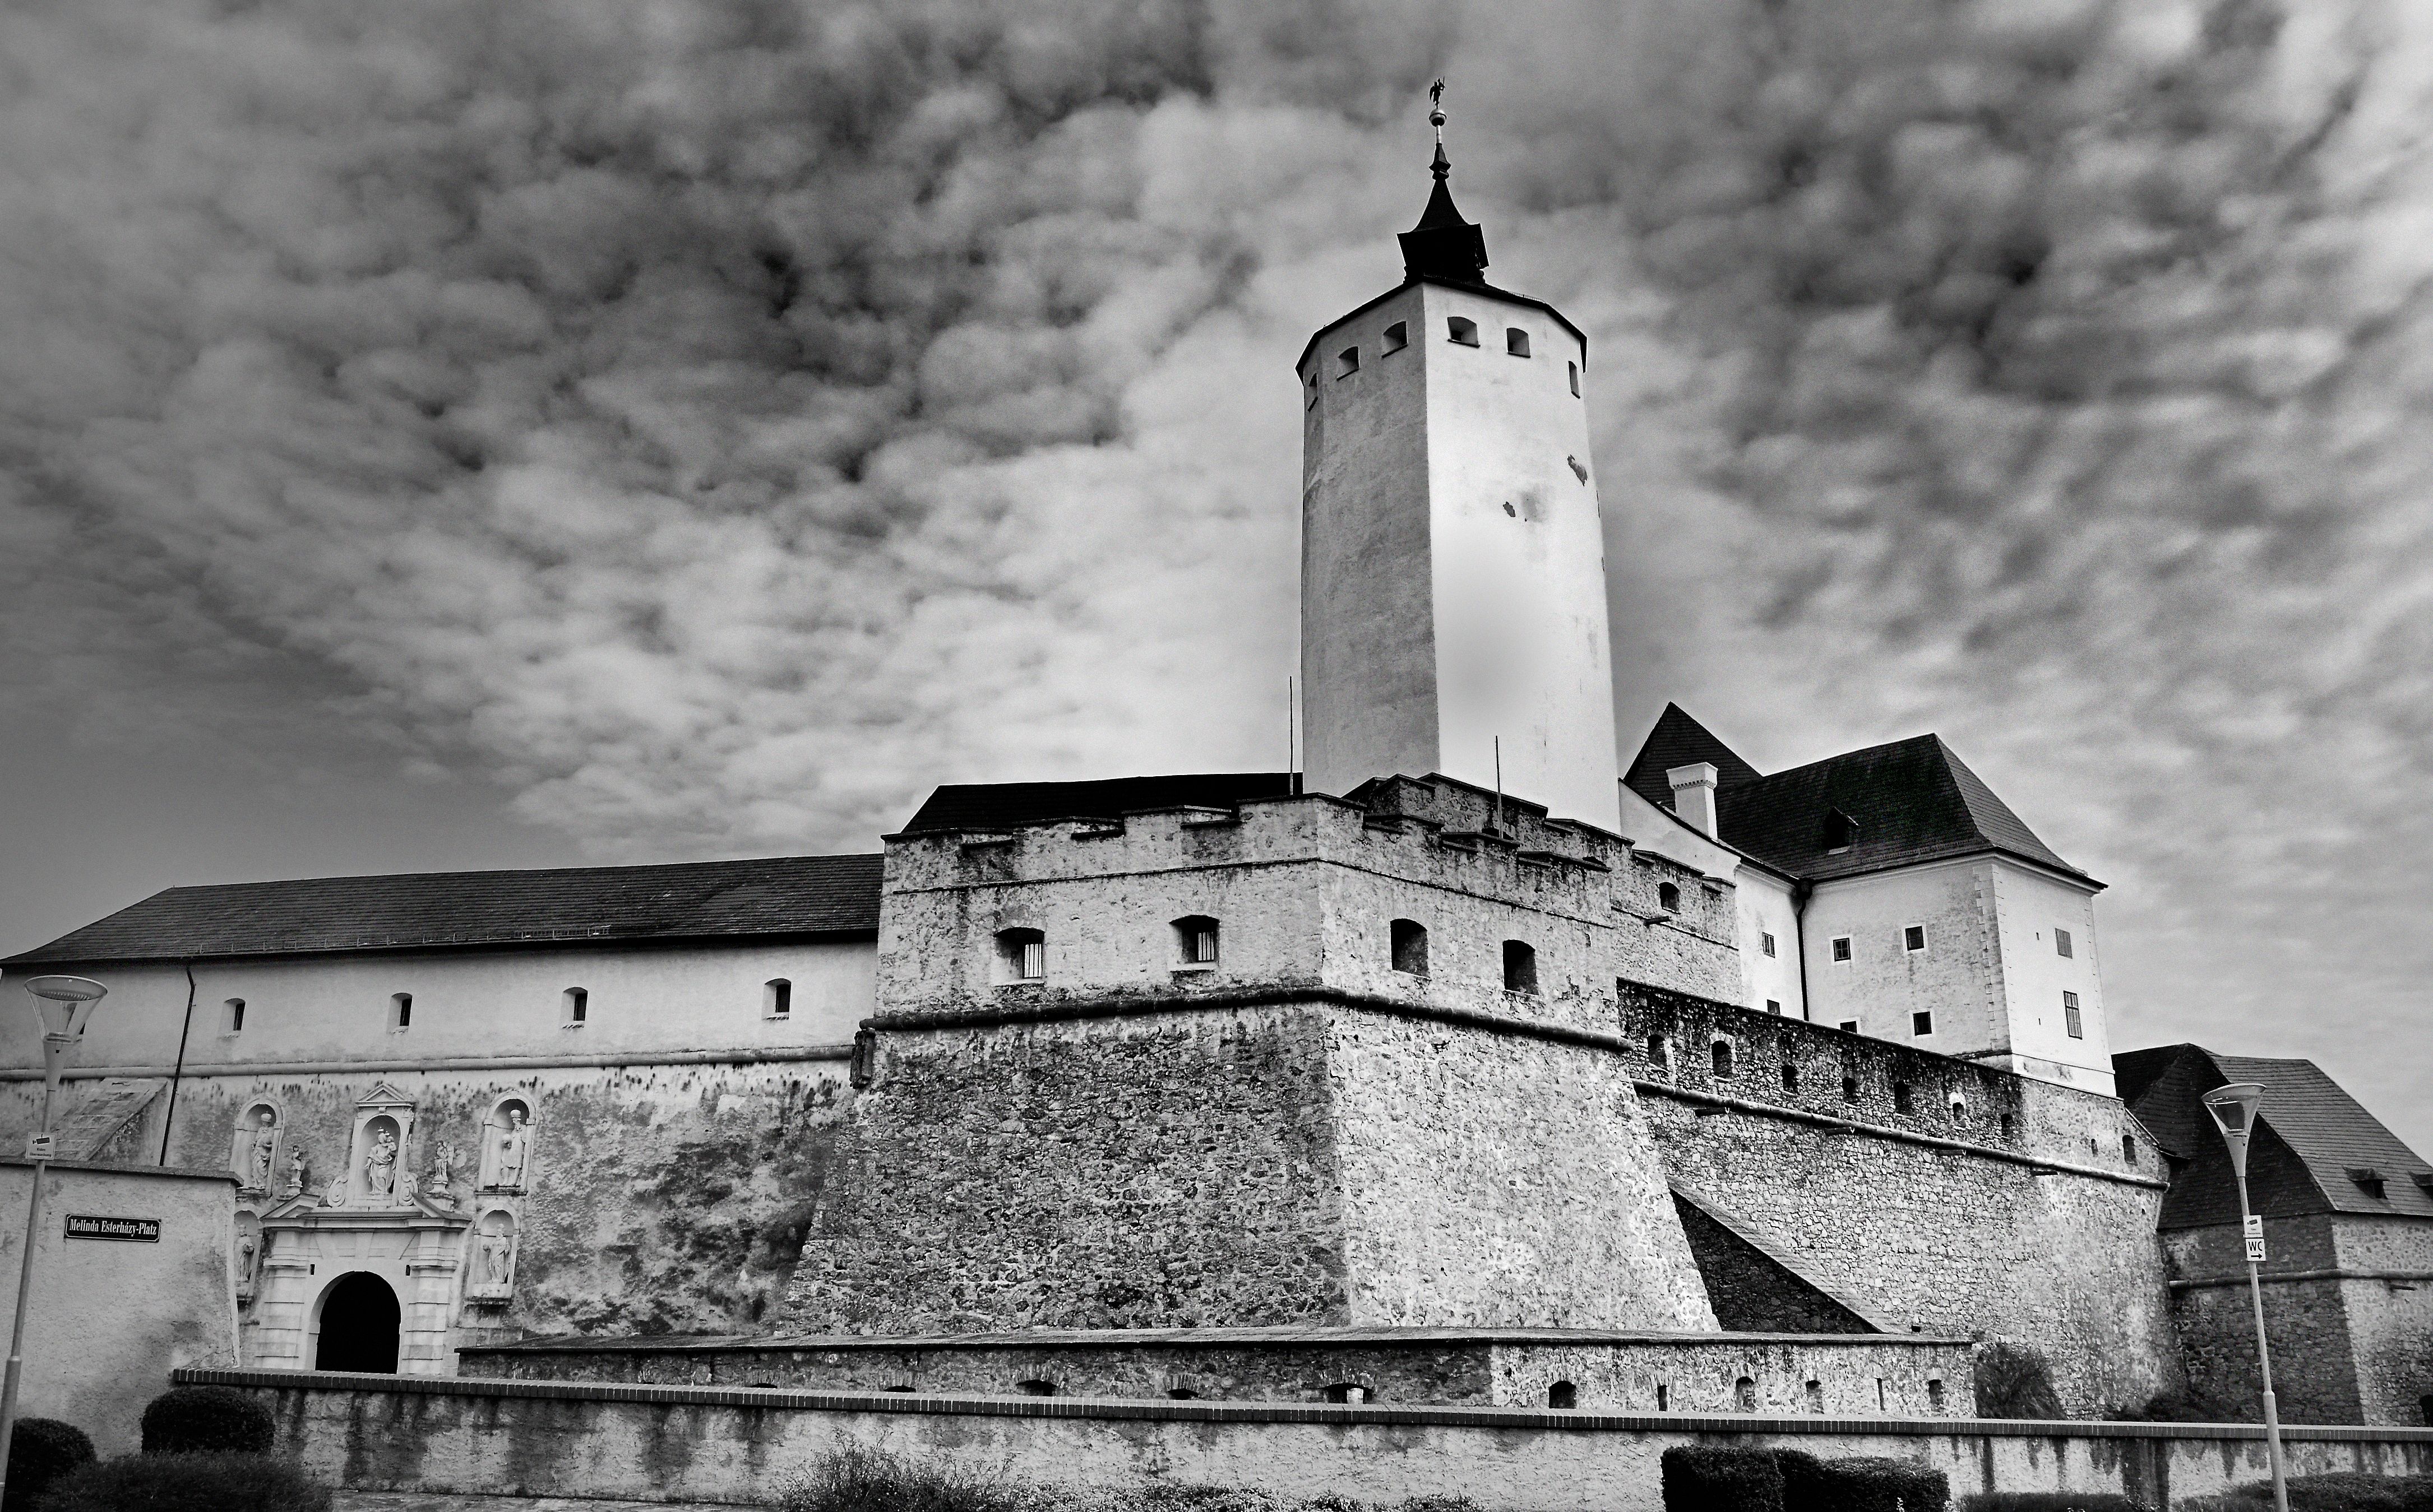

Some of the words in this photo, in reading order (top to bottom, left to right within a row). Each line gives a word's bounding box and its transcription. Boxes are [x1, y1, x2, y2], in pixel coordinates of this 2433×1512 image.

[69, 1219, 99, 1232] Melinda
[101, 1220, 157, 1237] Esterházy-Platz
[2248, 1241, 2263, 1251] WC
